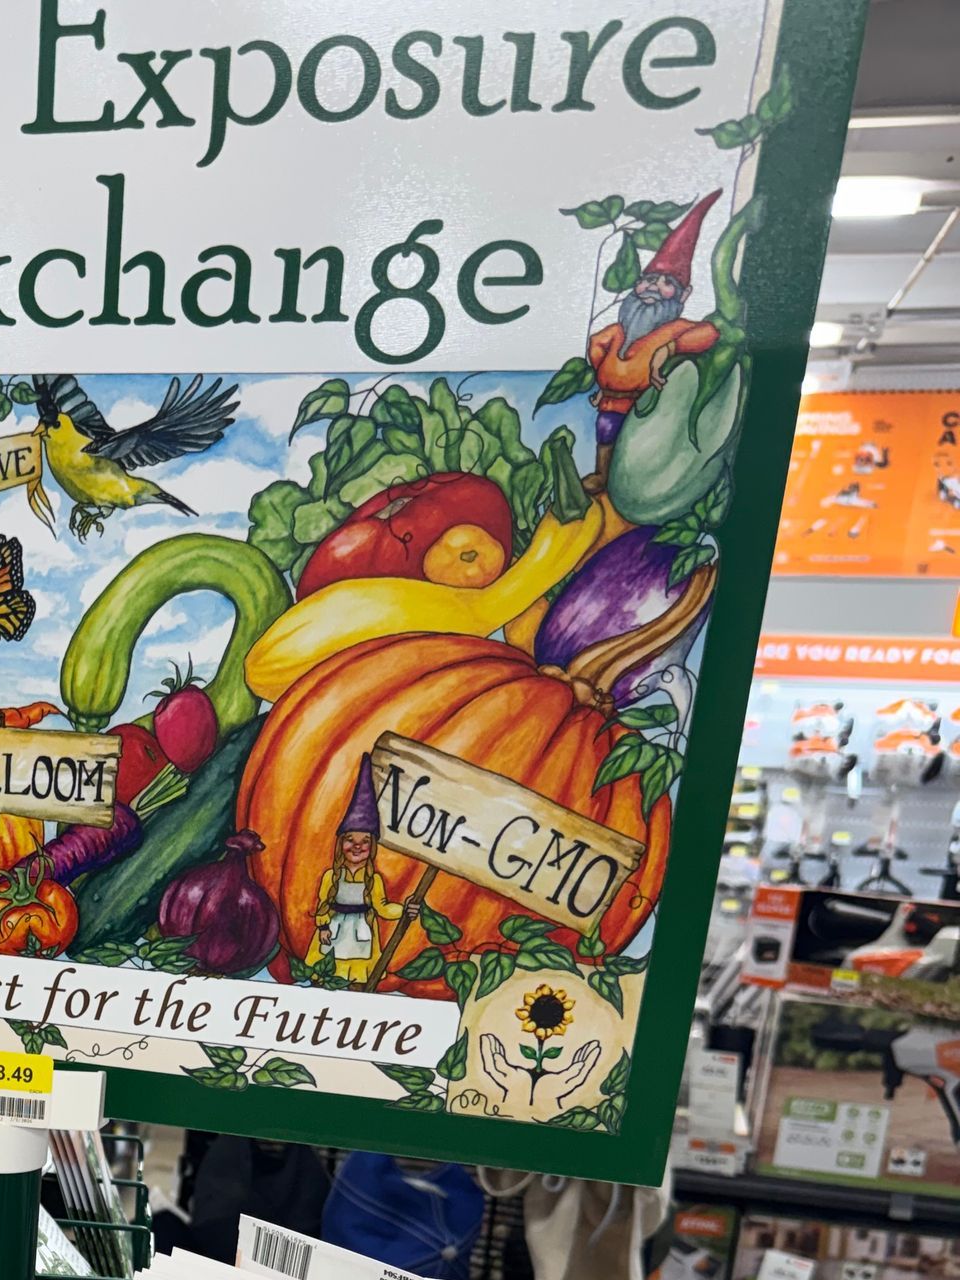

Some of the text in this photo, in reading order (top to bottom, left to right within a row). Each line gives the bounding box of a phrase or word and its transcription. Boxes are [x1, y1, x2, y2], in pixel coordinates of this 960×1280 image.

[20, 0, 717, 169] Exposure
[796, 644, 841, 661] YOU
[845, 646, 917, 664] READY
[42, 966, 119, 1030] for
[133, 980, 212, 1033] the
[234, 993, 422, 1056] Future
